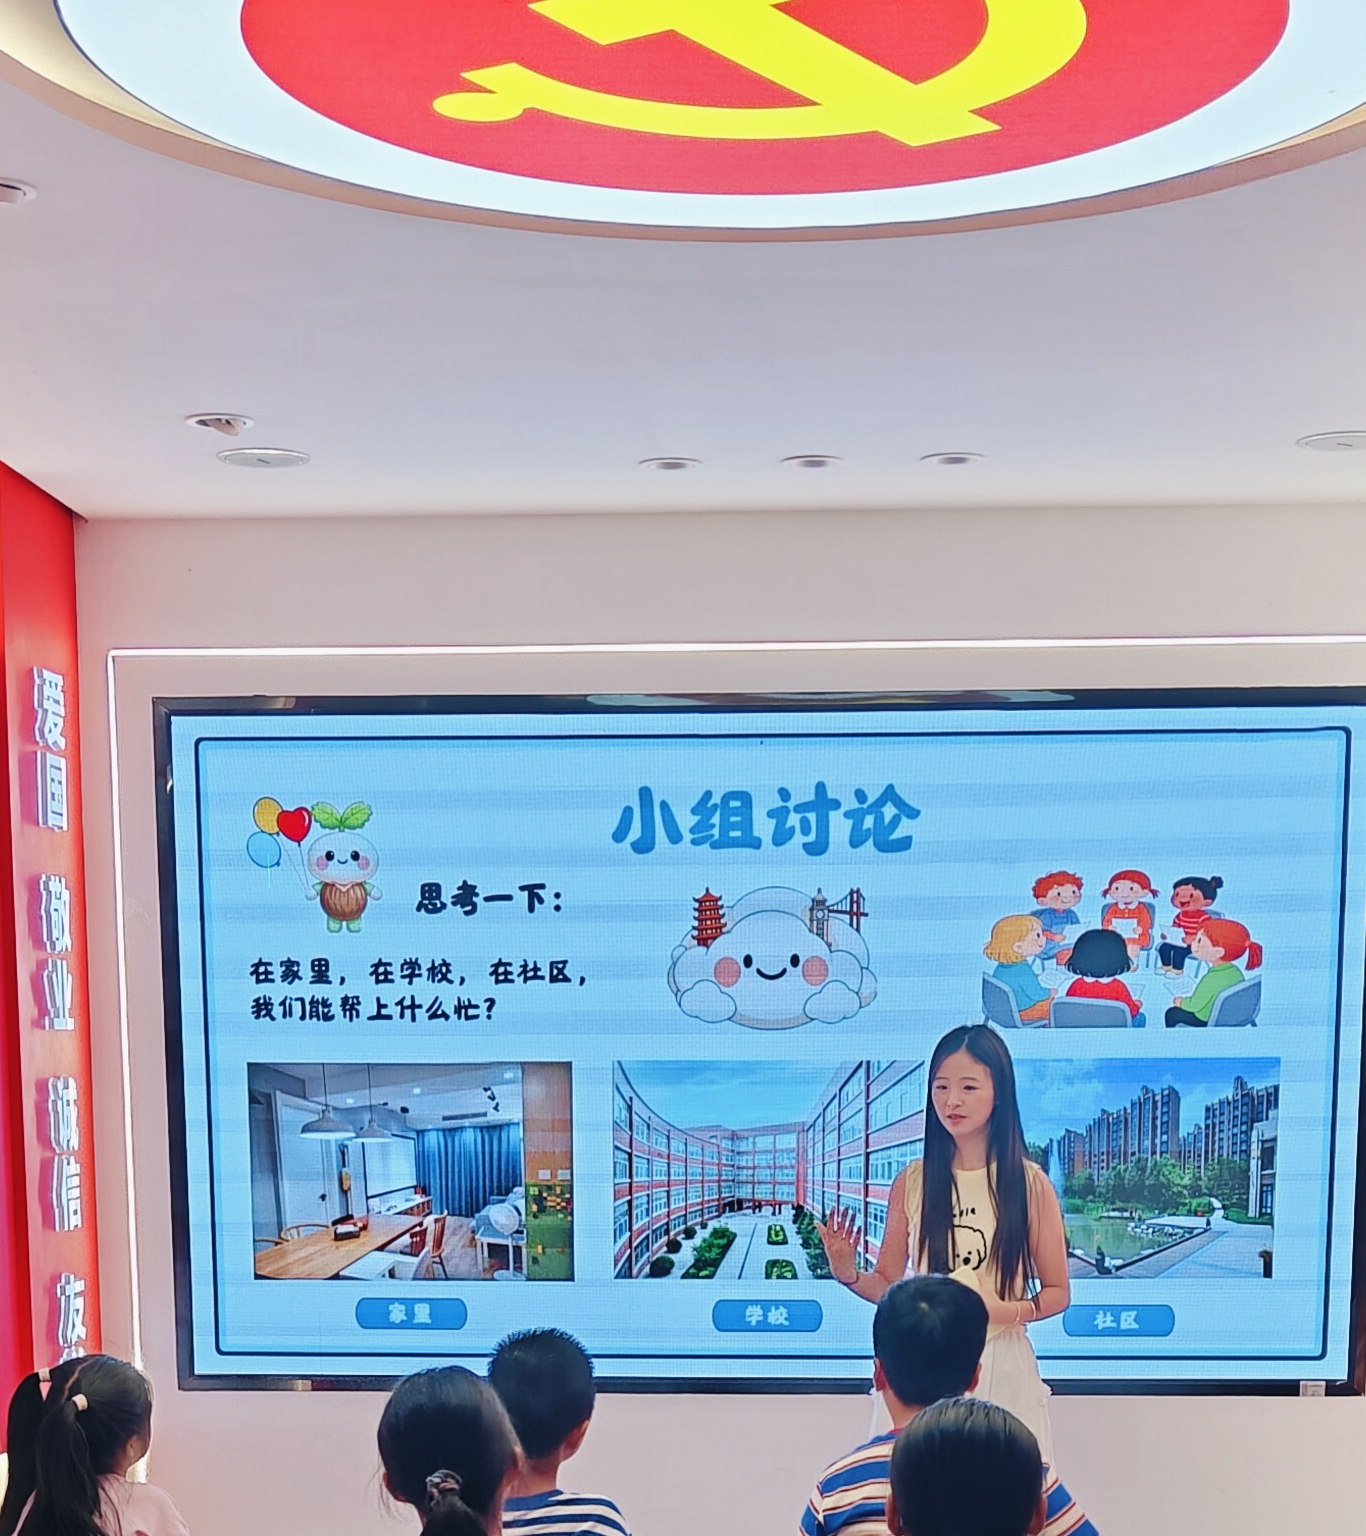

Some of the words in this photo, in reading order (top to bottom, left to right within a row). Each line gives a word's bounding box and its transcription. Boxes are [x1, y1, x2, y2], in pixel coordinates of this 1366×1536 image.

[33, 666, 68, 832] 爱国
[611, 781, 922, 857] 小组讨论
[415, 879, 562, 916] 思考一下：
[39, 873, 75, 1032] 敬业
[250, 993, 497, 1023] 我们能帮上什么忙？
[47, 1076, 84, 1233] 诚信
[388, 1302, 432, 1324] 家里
[745, 1304, 790, 1326] 学校
[1093, 1310, 1140, 1330] 社区
